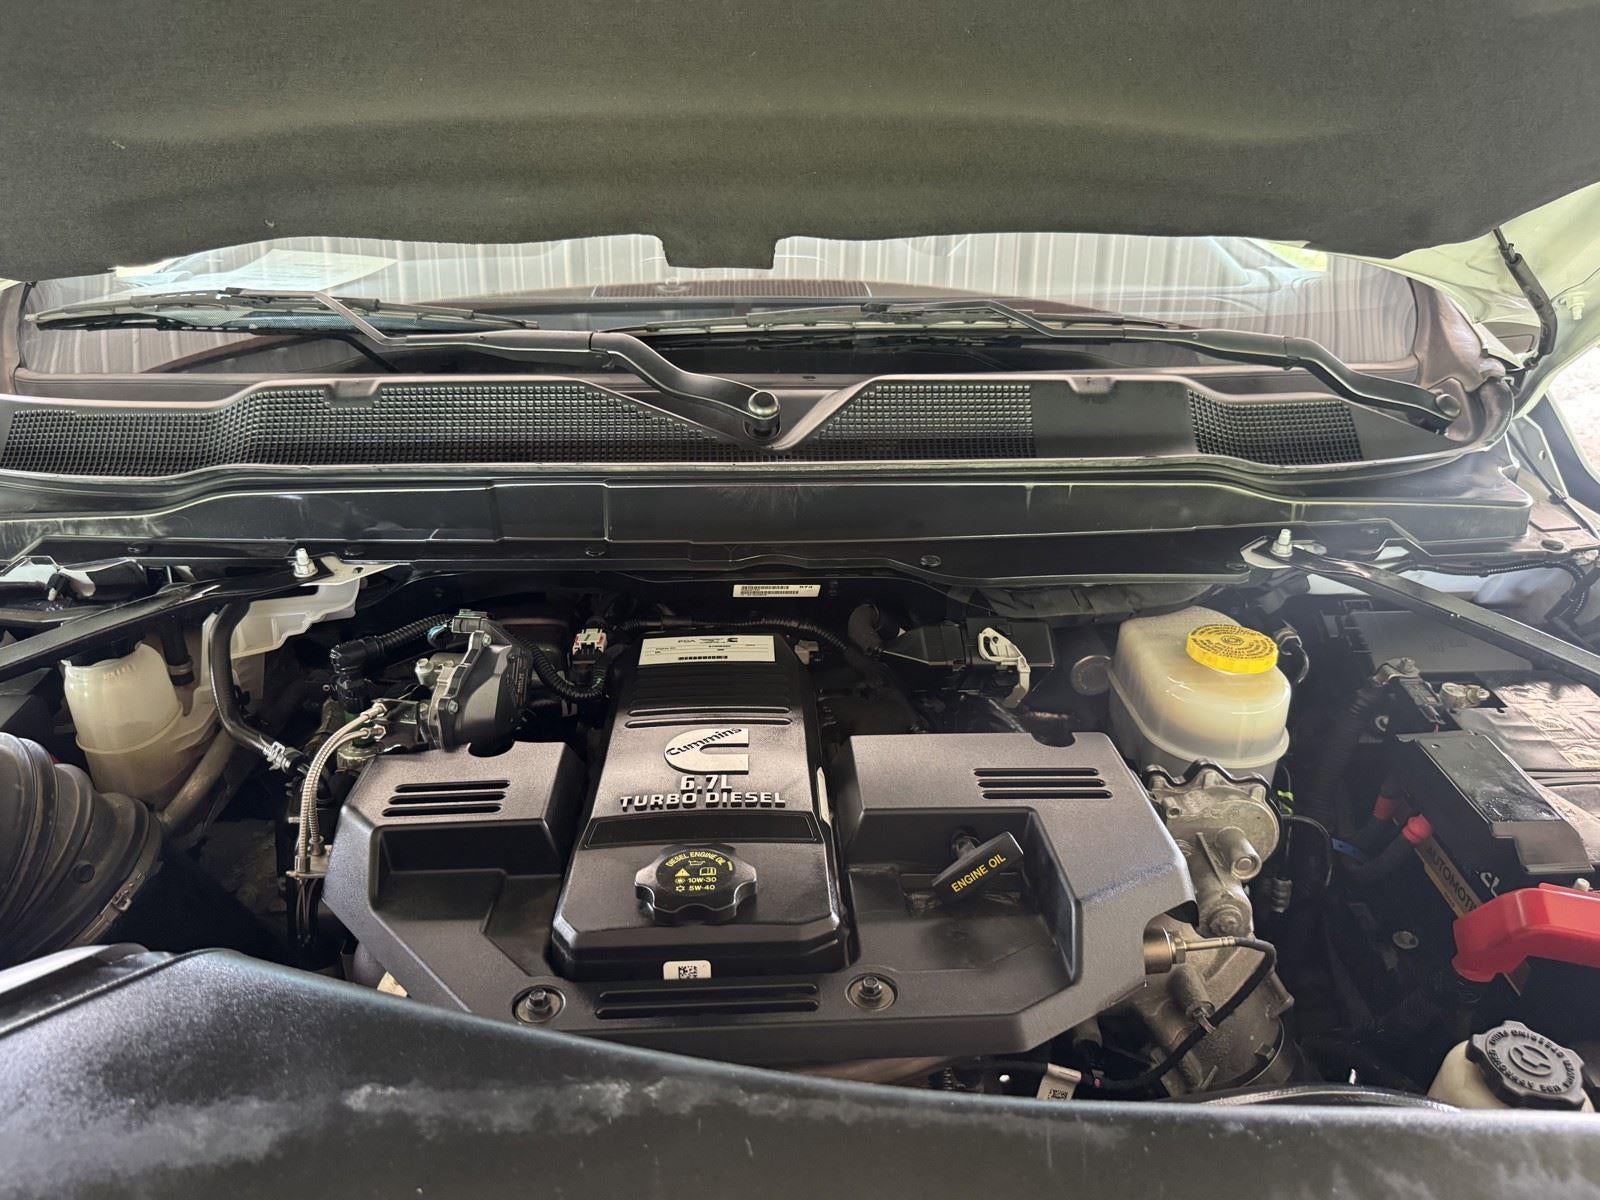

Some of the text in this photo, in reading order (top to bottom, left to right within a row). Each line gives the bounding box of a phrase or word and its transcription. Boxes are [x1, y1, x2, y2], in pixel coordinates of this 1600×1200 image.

[665, 727, 742, 756] Cummins
[680, 774, 733, 794] 6.7L
[620, 791, 786, 811] TURBO DIESEL
[665, 853, 689, 867] DIESEL
[689, 851, 718, 860] ENGINE
[951, 853, 1007, 893] ENGINE OIL
